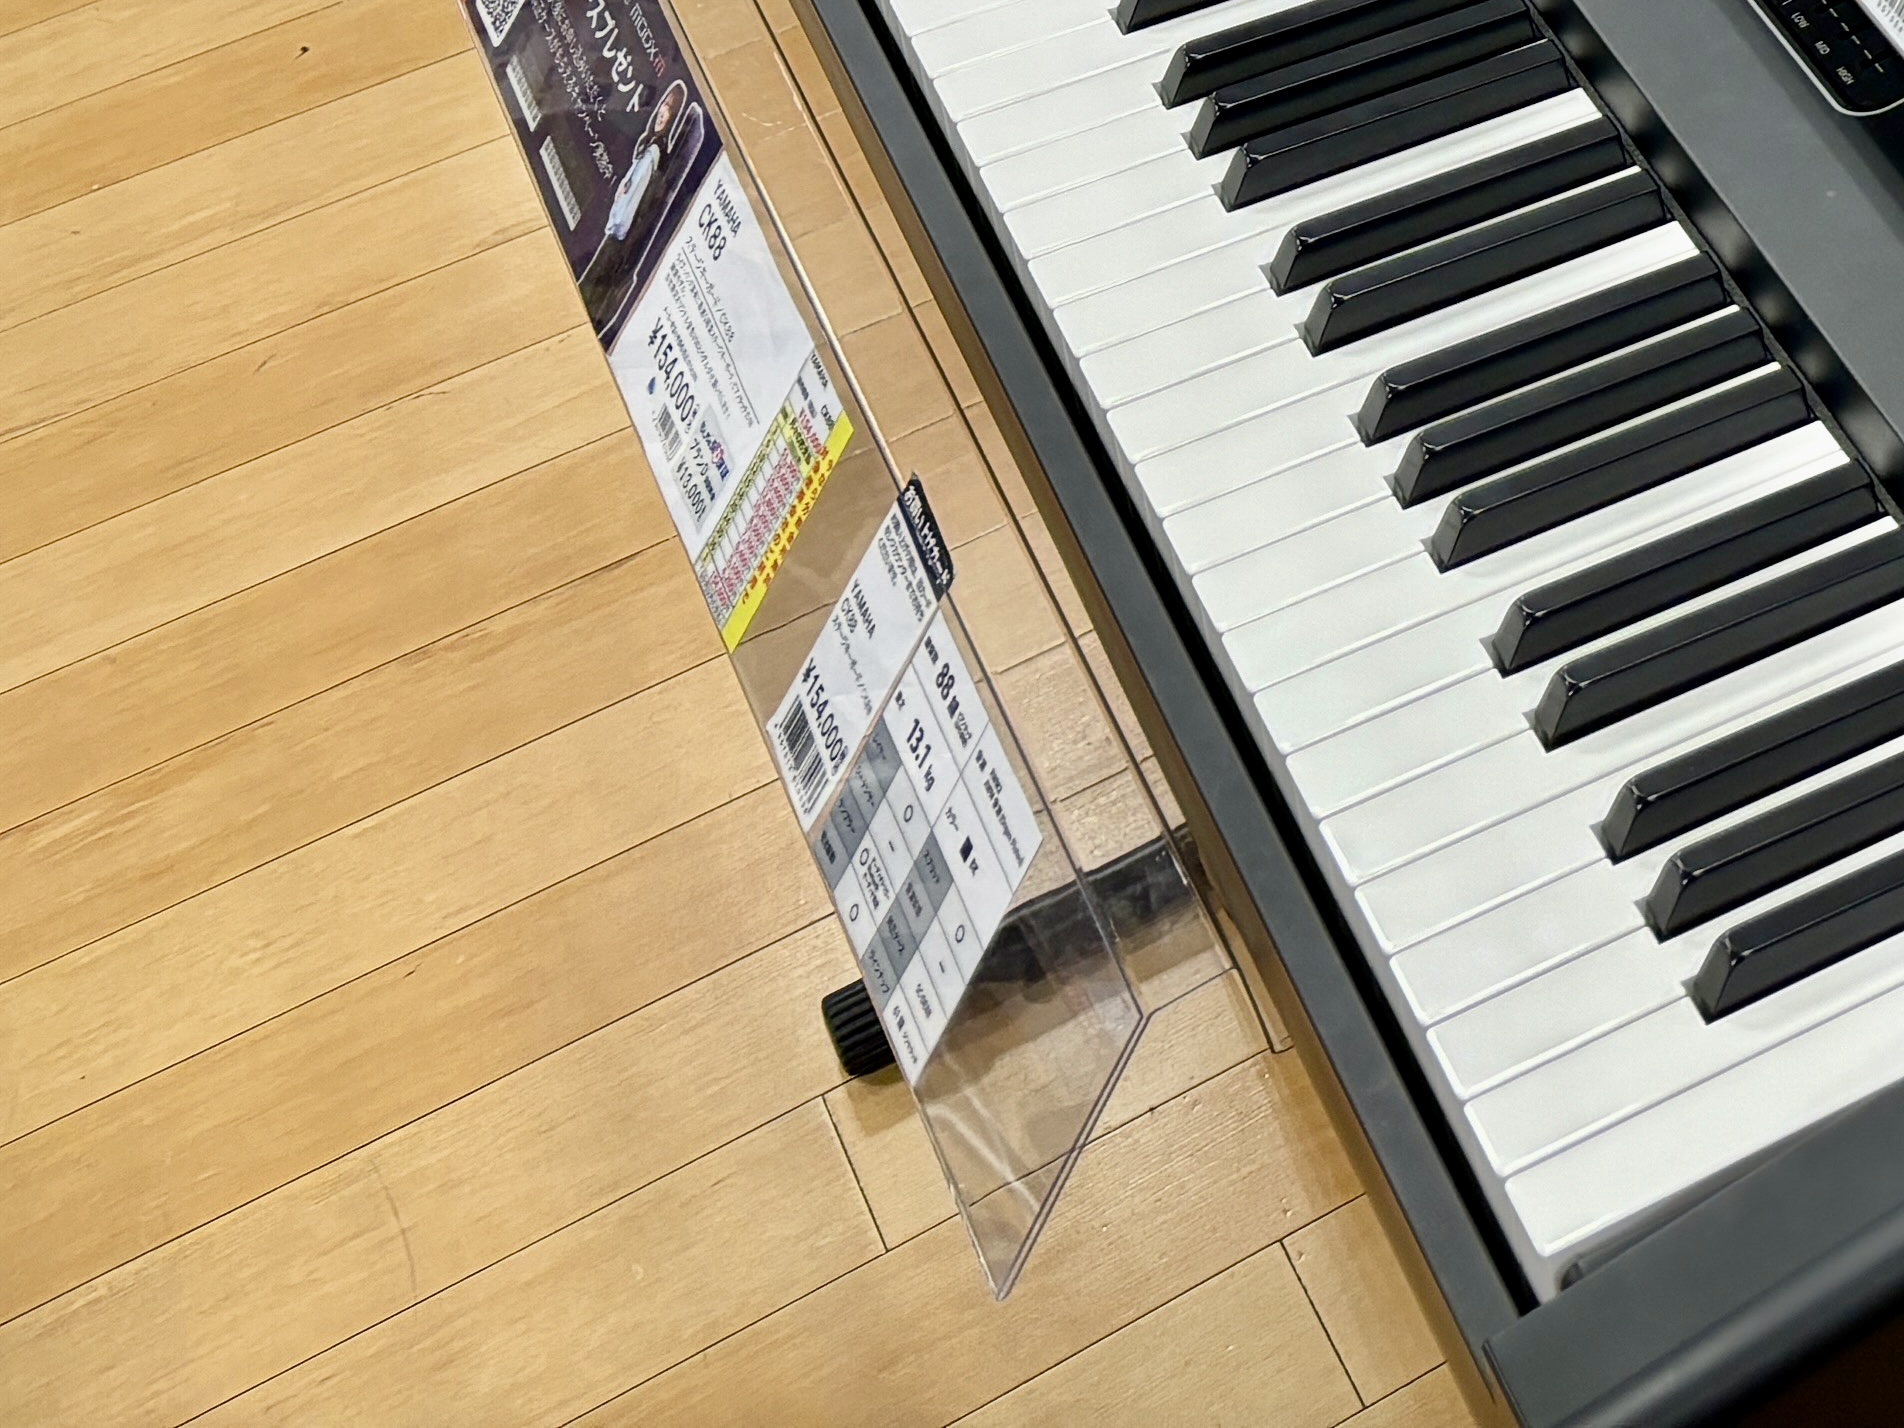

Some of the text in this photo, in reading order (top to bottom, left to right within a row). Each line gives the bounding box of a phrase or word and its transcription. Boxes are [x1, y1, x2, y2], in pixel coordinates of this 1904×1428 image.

[1791, 12, 1810, 30] LOW
[1814, 40, 1831, 56] MID
[1835, 66, 1855, 86] HIGH
[696, 199, 728, 265] CK88
[712, 177, 742, 239] YAMAHA
[646, 316, 696, 428] ¥154,000
[849, 577, 877, 640] YAMAHA
[798, 656, 846, 765] ¥154,000
[934, 659, 956, 703] 88
[904, 714, 937, 794] 13.1 kg
